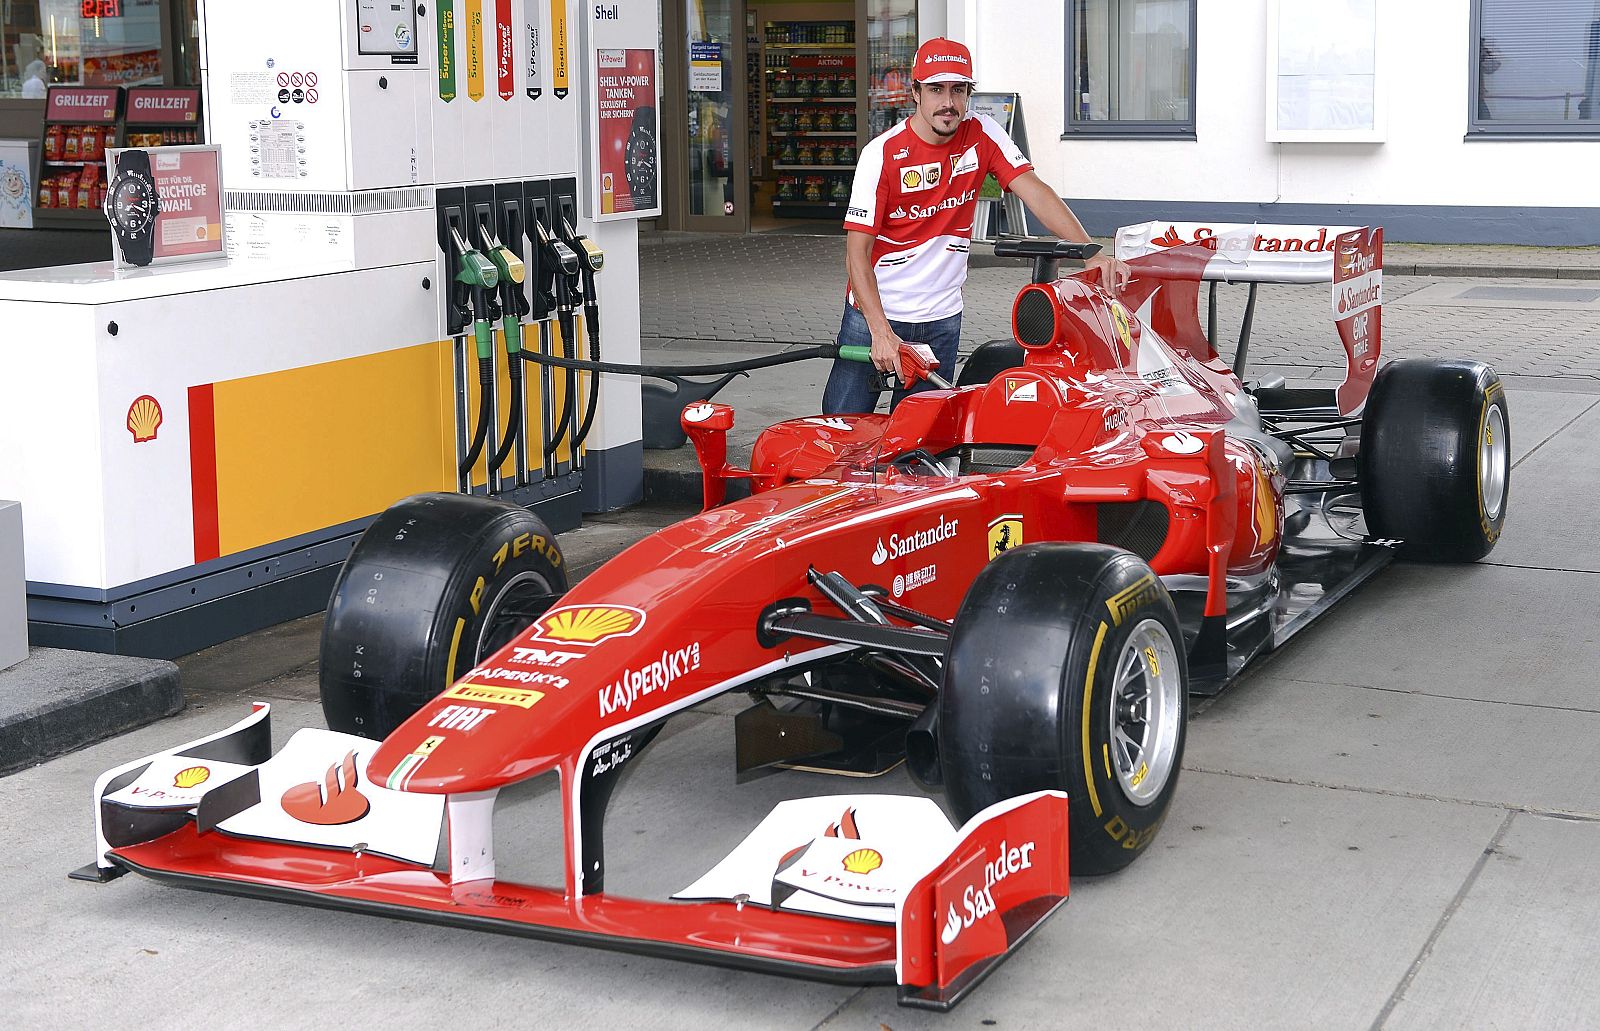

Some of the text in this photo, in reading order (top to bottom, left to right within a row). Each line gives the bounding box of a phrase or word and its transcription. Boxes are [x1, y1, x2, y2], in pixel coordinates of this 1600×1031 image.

[475, 11, 481, 25] 95
[595, 5, 619, 20] Shell
[442, 44, 450, 79] Super
[600, 55, 624, 64] V-Power
[817, 58, 844, 66] AKTION
[932, 54, 969, 66] Santander
[600, 76, 649, 87] SHELL V-POWER
[606, 87, 635, 99] TANKEN,
[54, 95, 109, 108] GRILLZEIT
[134, 97, 190, 110] GRILLZEIT
[600, 100, 627, 109] EXKLUSIVE
[600, 110, 612, 119] UHR
[157, 177, 169, 185] ZEIT
[170, 175, 182, 184] FÜR
[927, 171, 939, 184] ups
[159, 183, 208, 199] RICHTIGE
[117, 201, 123, 209] 9
[141, 200, 148, 208] 3
[130, 219, 136, 228] 6
[1346, 277, 1380, 311] Santander
[889, 513, 959, 560] Santander
[470, 532, 561, 616] P ZERO
[367, 588, 378, 605] 20
[512, 646, 588, 665] TNT
[353, 661, 363, 678] 97
[466, 666, 562, 686] KASPERSKY
[598, 645, 692, 719] KASPERSKY
[455, 687, 532, 703] PIRELLI
[427, 704, 497, 731] FIAT
